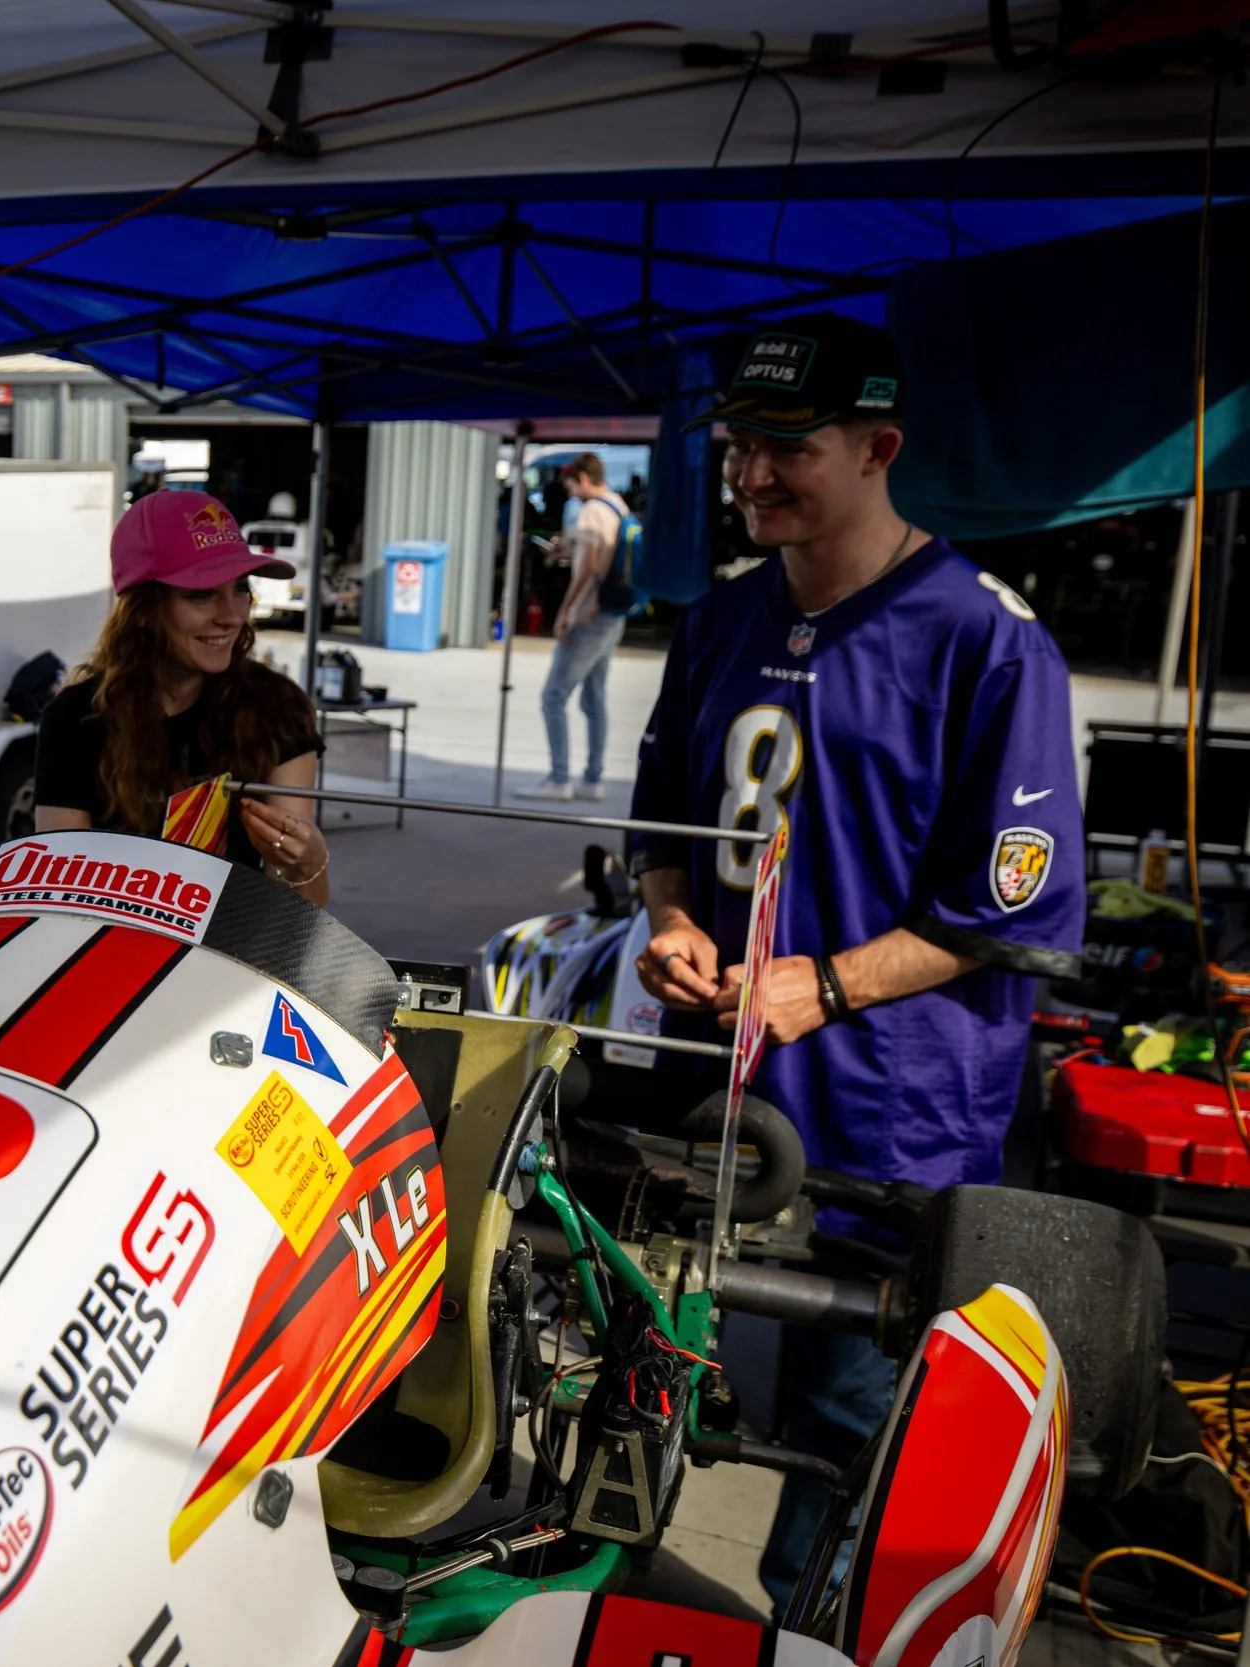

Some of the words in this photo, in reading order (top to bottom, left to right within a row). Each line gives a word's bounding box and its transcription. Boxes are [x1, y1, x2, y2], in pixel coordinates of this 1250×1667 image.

[744, 363, 797, 382] OPTUS
[759, 666, 817, 684] RAVENS
[716, 704, 804, 892] 8
[62, 893, 197, 931] FRAMING
[244, 1099, 272, 1137] SUPER
[252, 1109, 282, 1149] SERIES
[279, 1161, 319, 1220] SCRUTINEERING
[20, 1263, 137, 1441] SUPER
[52, 1290, 168, 1490] SERIES
